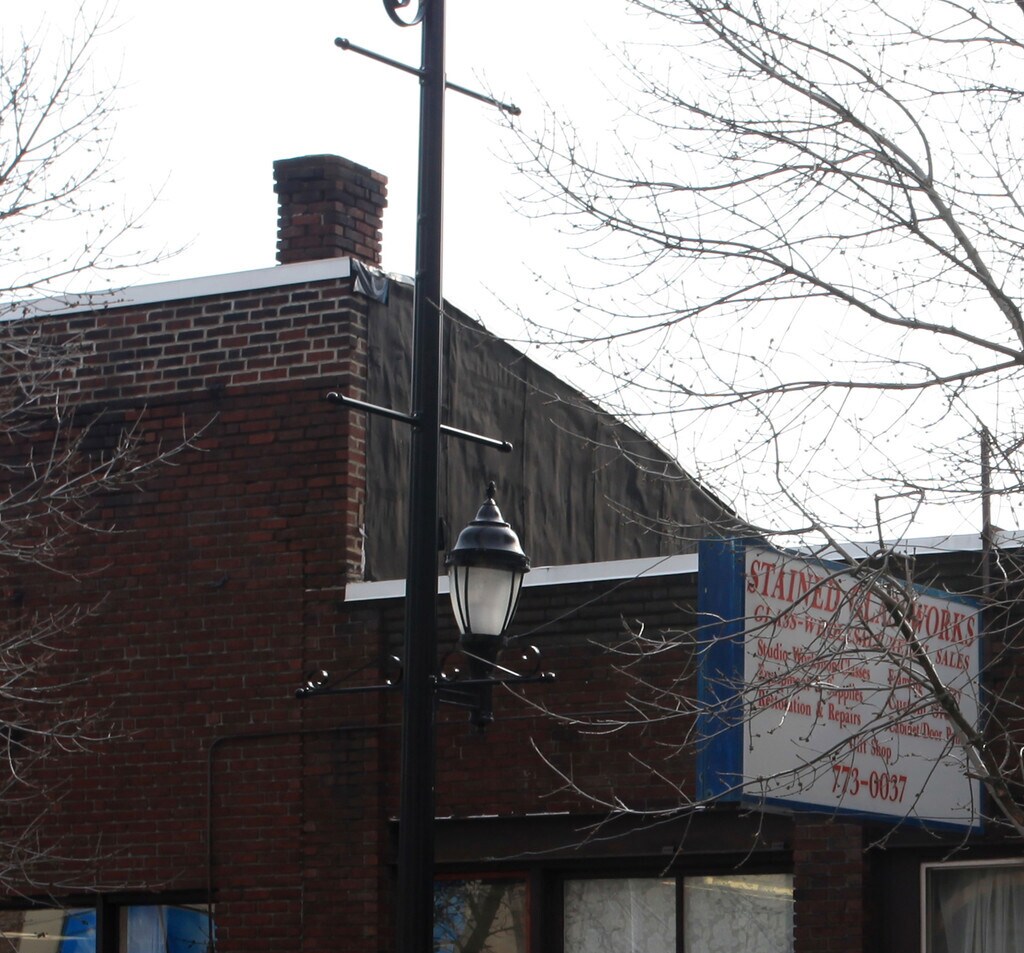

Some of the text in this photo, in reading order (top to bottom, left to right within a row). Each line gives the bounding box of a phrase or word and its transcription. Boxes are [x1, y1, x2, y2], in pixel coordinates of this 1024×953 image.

[747, 559, 841, 613] STAINED
[910, 601, 976, 648] WORKS
[757, 639, 788, 661] Studio
[935, 648, 970, 671] SALES
[828, 703, 862, 729] Repairs
[871, 738, 892, 764] Shop
[832, 765, 908, 803] 773-0037
